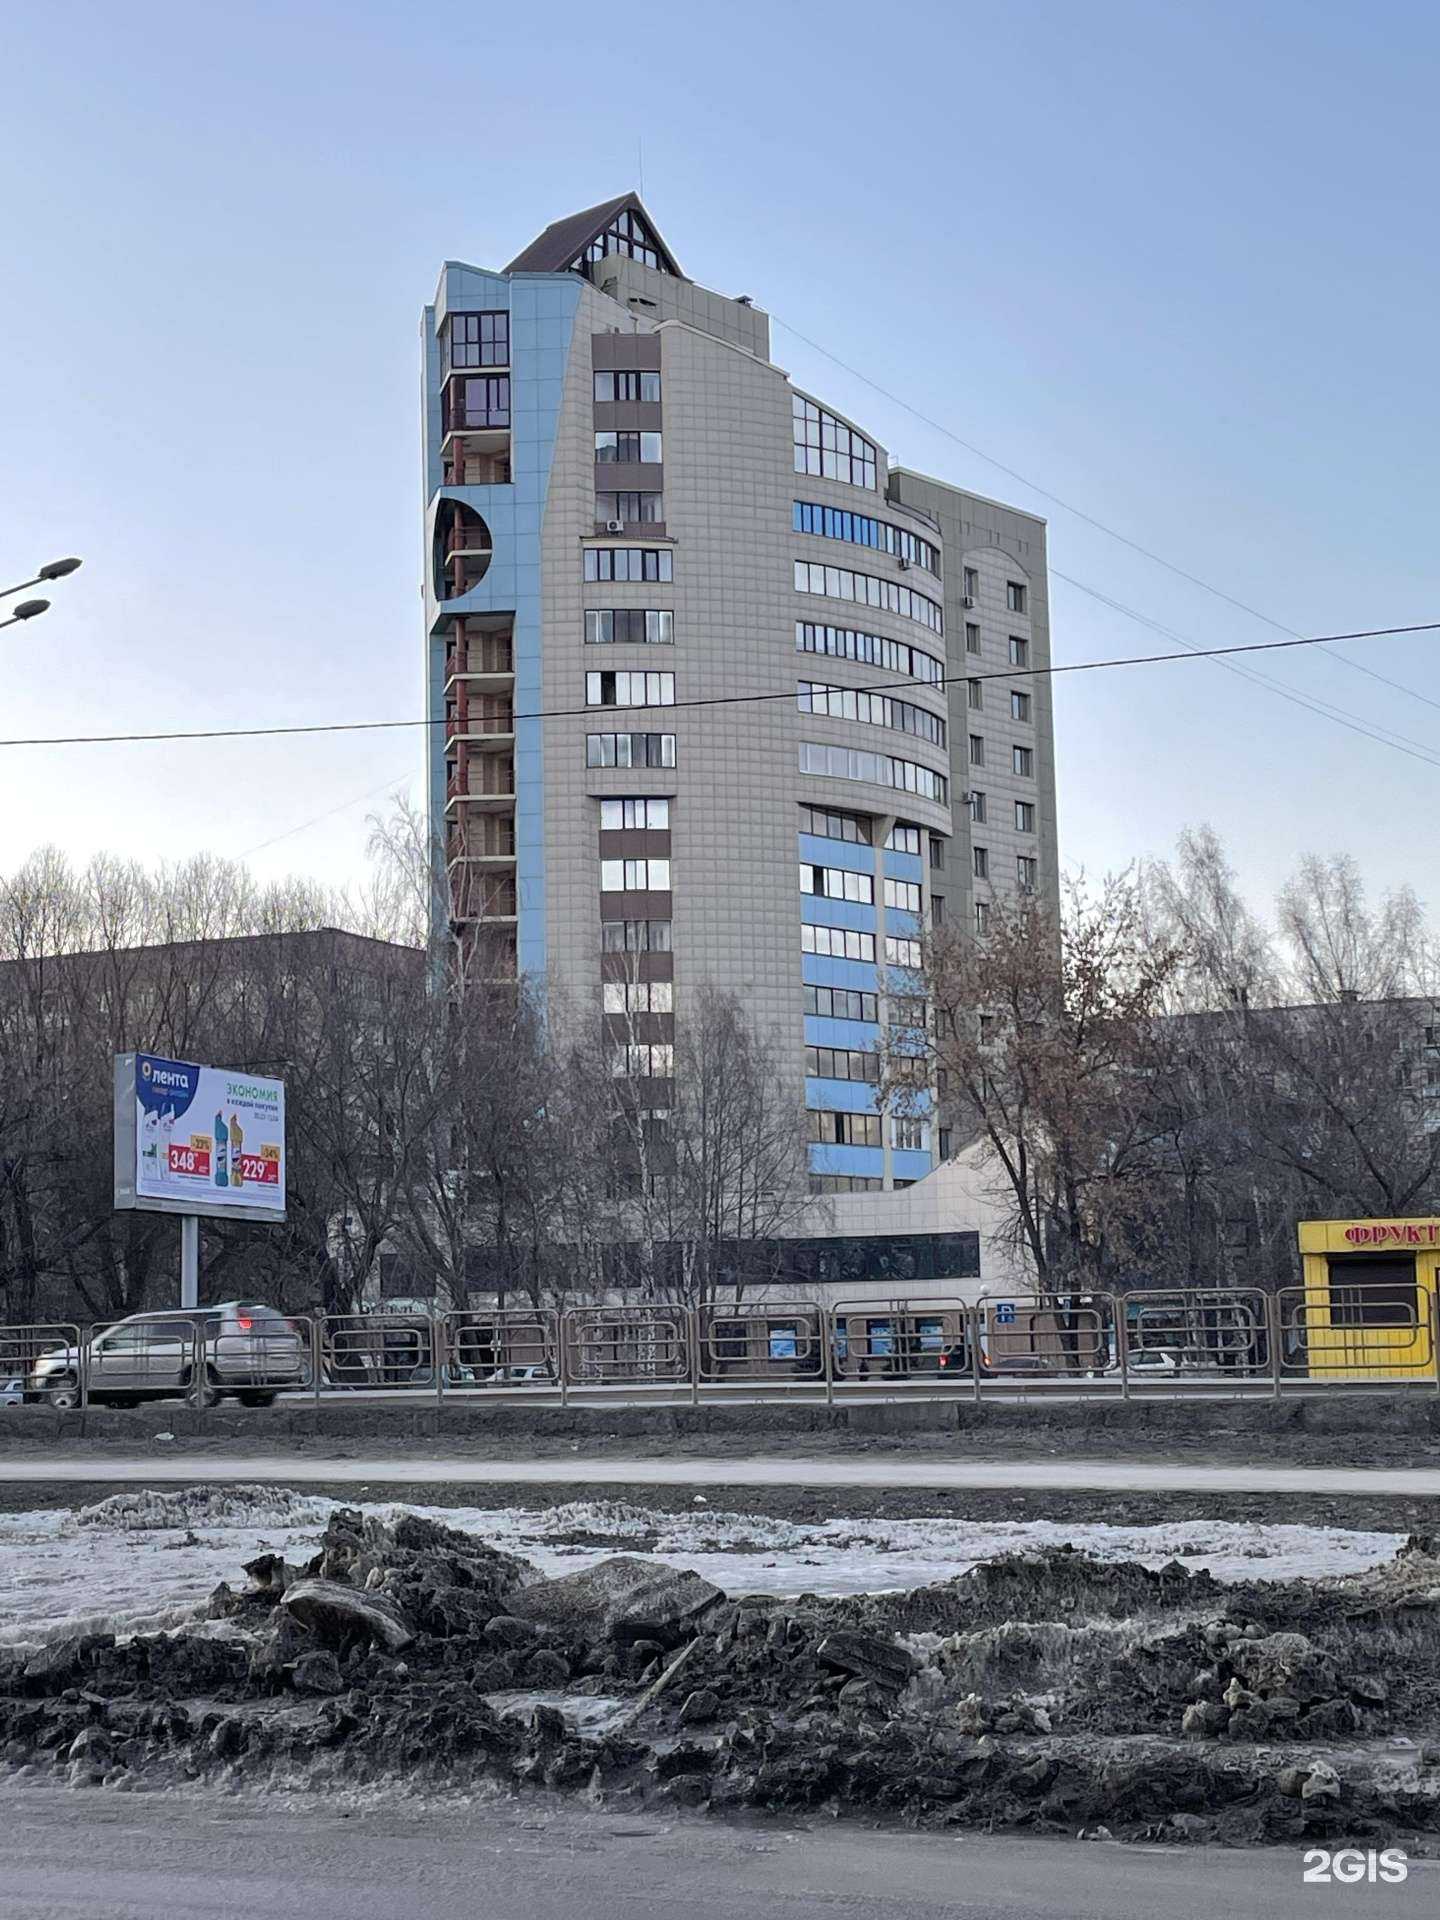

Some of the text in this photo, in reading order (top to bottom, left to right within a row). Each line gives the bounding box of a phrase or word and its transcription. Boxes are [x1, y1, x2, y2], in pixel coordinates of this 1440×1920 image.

[152, 1070, 189, 1088] лента
[226, 1083, 278, 1101] ЭКОНОМИЯ
[171, 1150, 195, 1171] 348
[242, 1159, 265, 1179] 229
